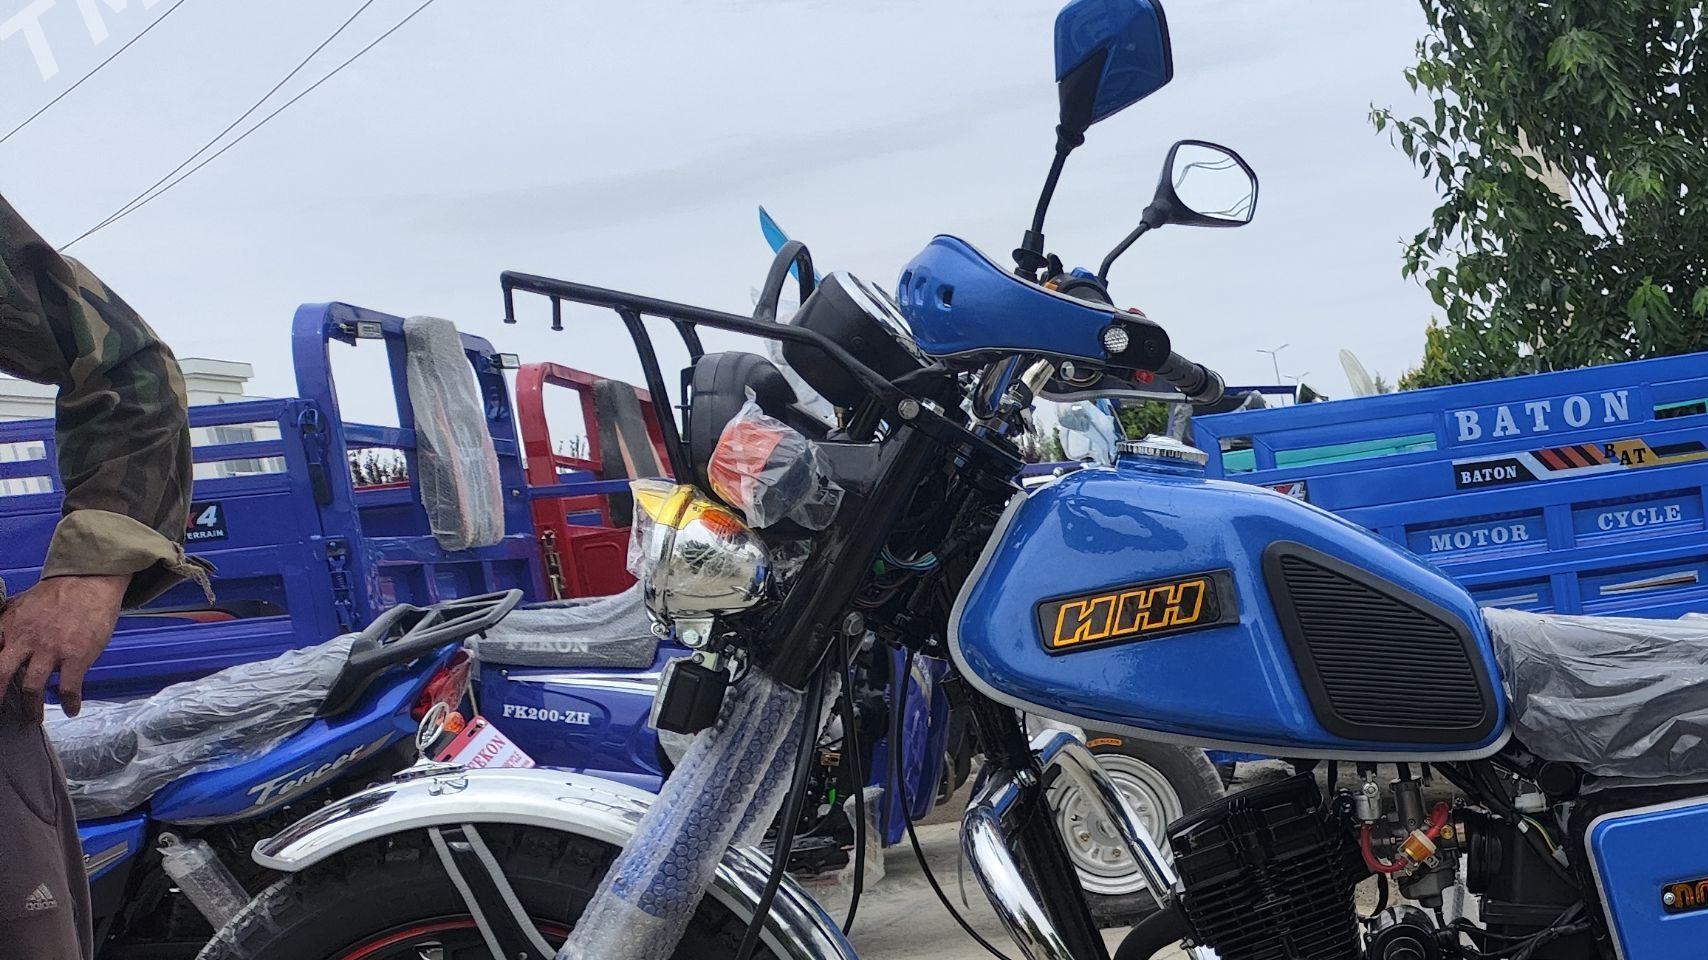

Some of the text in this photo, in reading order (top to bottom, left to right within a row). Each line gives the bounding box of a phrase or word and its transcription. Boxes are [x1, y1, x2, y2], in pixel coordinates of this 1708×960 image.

[1454, 390, 1629, 442] BATON
[1461, 465, 1517, 484] BATON
[187, 529, 224, 540] ERRAIN
[1430, 504, 1682, 552] MOTOR CYCLE
[502, 704, 591, 726] FK200-ZH
